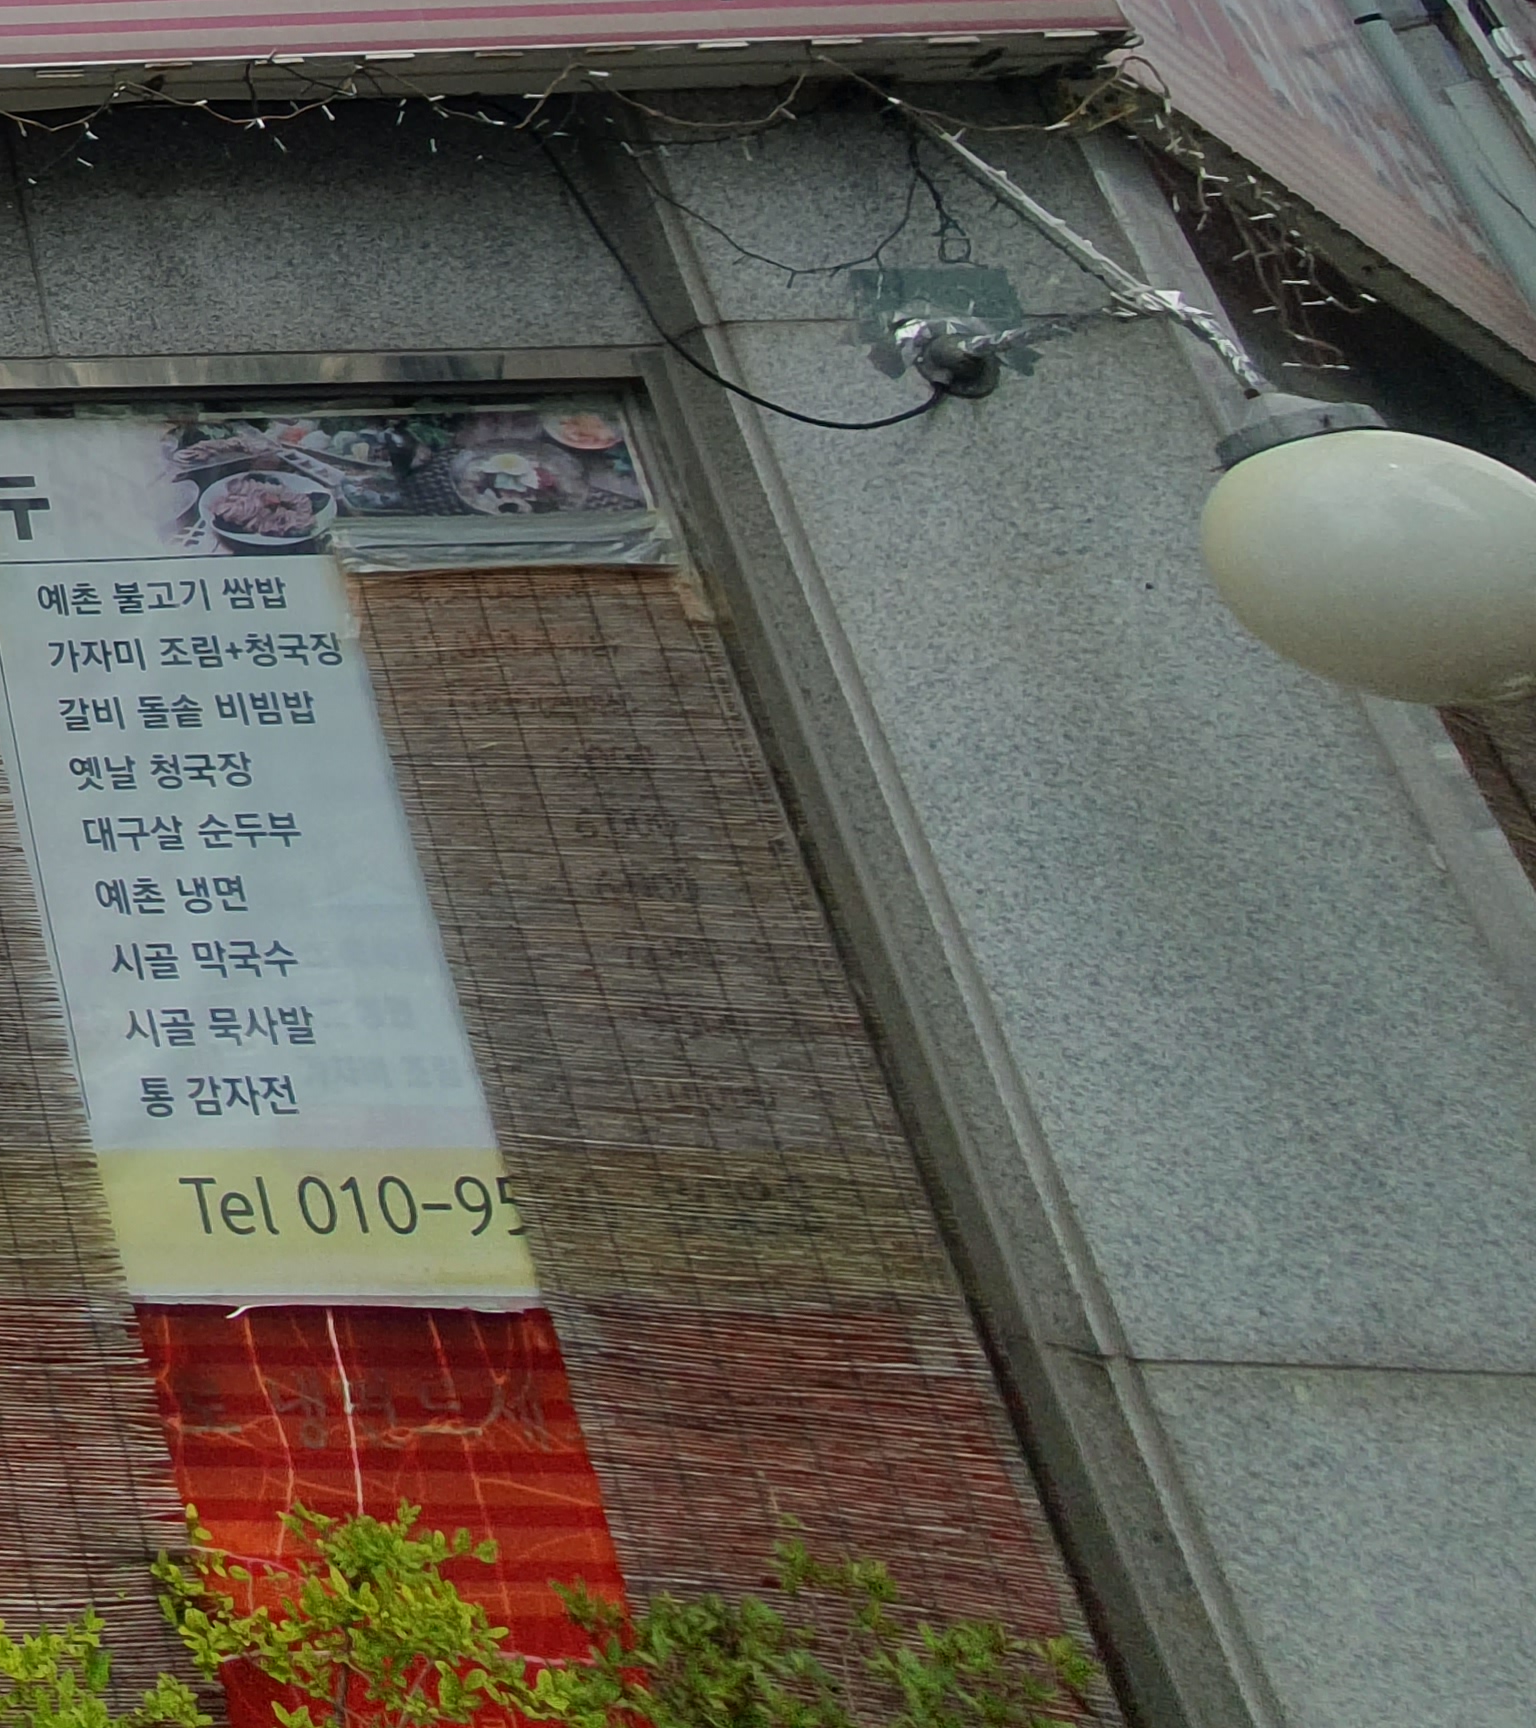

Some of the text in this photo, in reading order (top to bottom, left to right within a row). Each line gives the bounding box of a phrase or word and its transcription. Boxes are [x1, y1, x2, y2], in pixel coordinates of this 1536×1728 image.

[37, 576, 288, 616] 예촌 불고기 쌈밥
[47, 638, 147, 673] 가자미
[58, 690, 317, 732] 갈비 돌솥 비빔밥
[68, 751, 254, 791] 옛날 청국장
[82, 812, 302, 852] 대구살 순두부
[95, 874, 249, 917] 예촌 냉면
[111, 939, 299, 981] 시골 막국수
[125, 1005, 316, 1048] 시골 묵사발
[140, 1075, 300, 1117] 통 감자전
[178, 1175, 281, 1236] Tel
